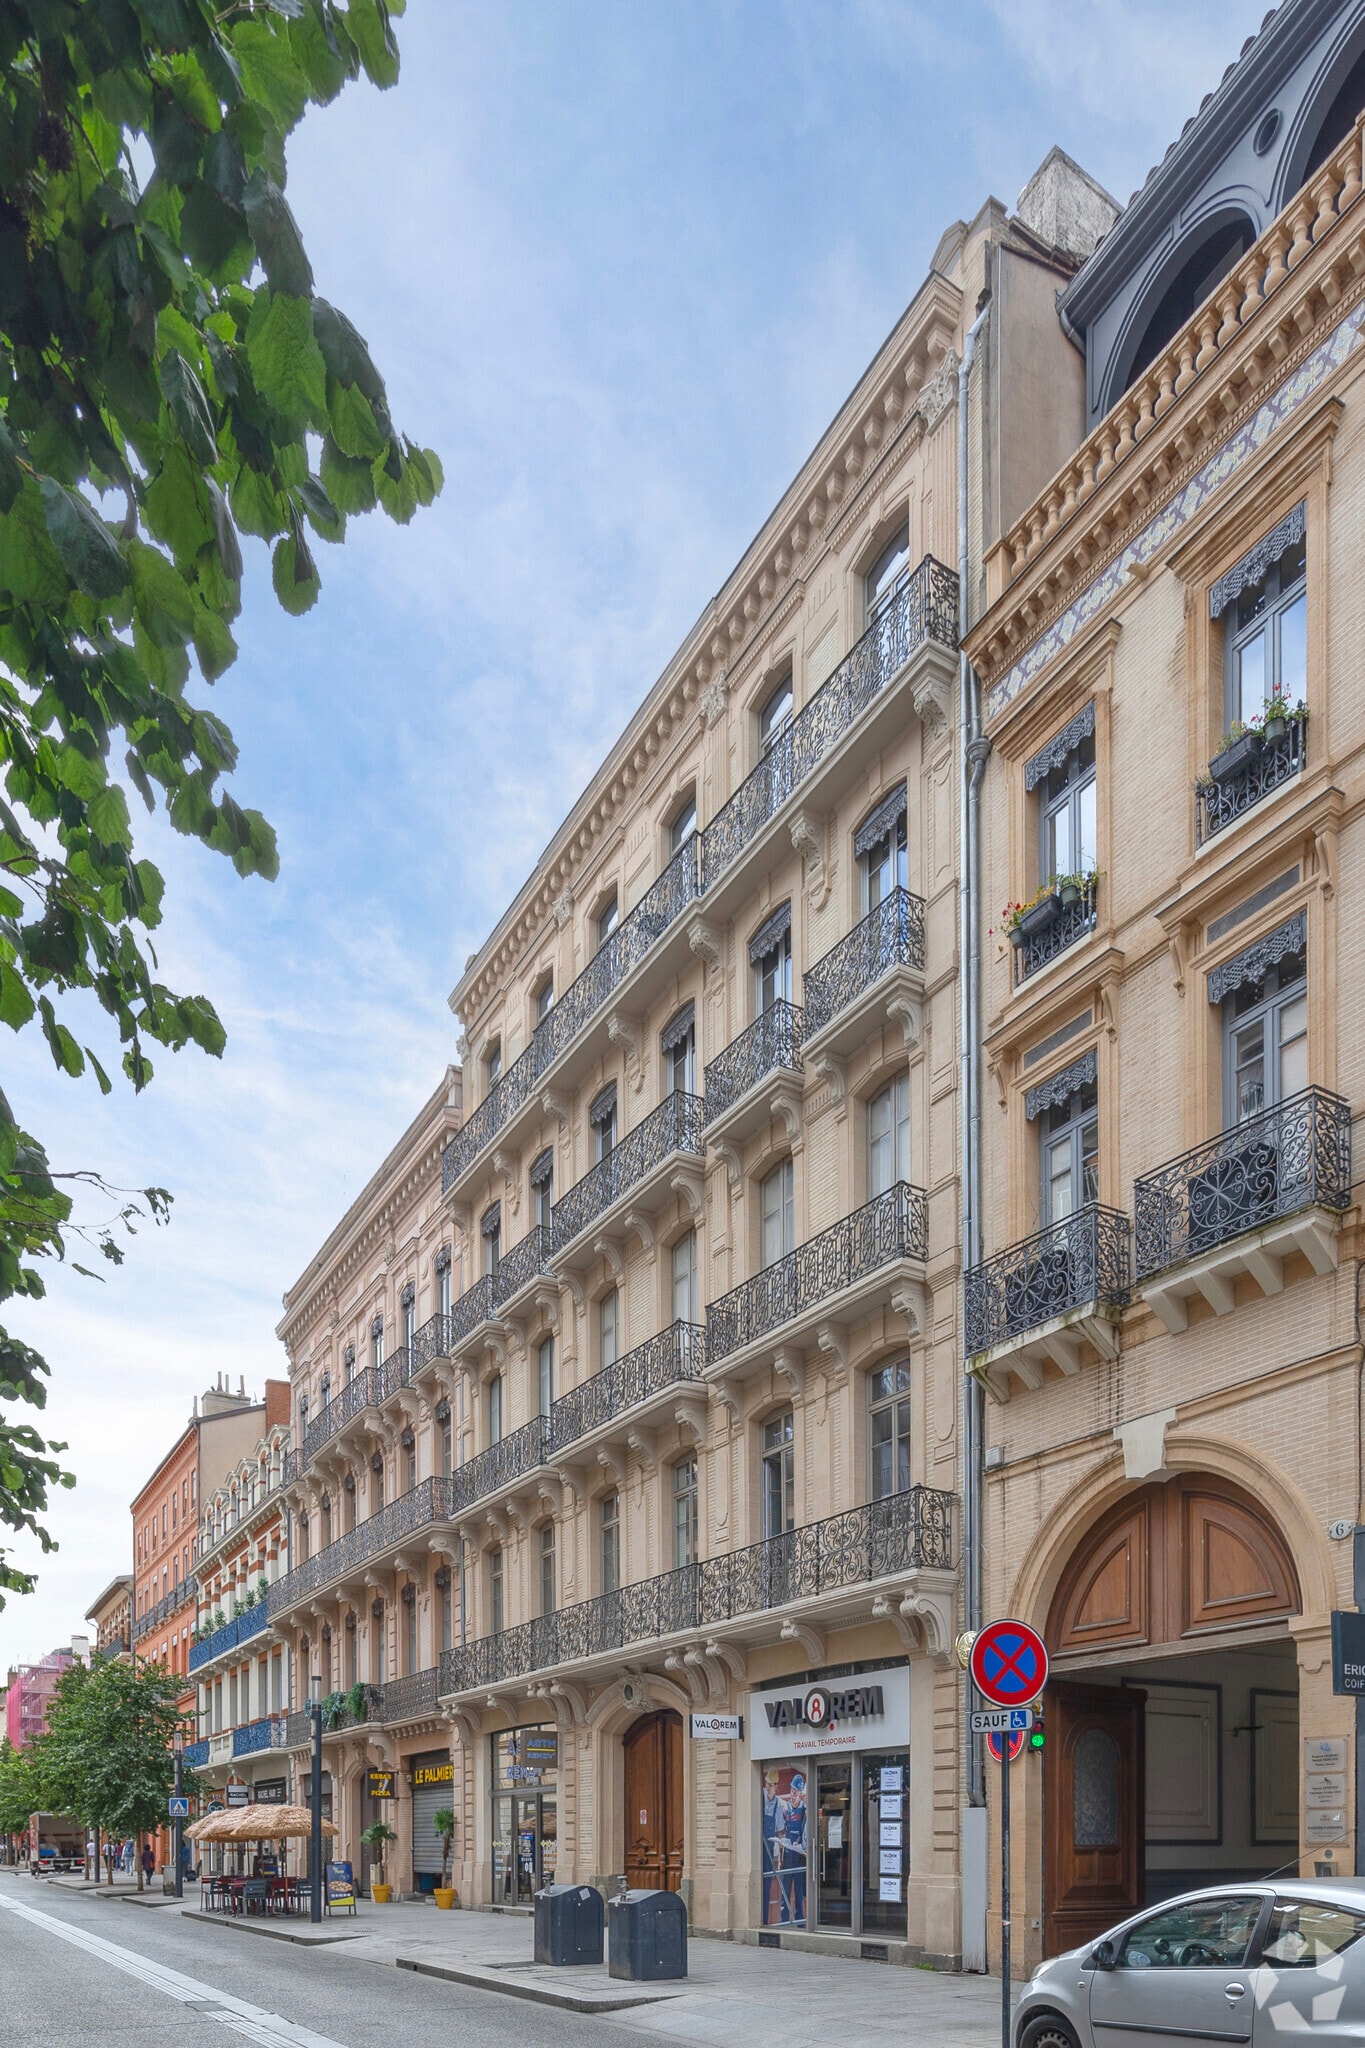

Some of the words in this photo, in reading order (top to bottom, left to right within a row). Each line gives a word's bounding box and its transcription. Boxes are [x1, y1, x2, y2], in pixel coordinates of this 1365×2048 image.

[1335, 1522, 1345, 1537] 6
[764, 1686, 884, 1730] VALOREM
[694, 1719, 737, 1730] VALOREM
[974, 1714, 1008, 1728] SAUF
[794, 1739, 817, 1749] TRAVAIL
[818, 1735, 857, 1748] TEMPORAIRE
[415, 1769, 424, 1784] LE
[424, 1765, 454, 1783] PALMIER
